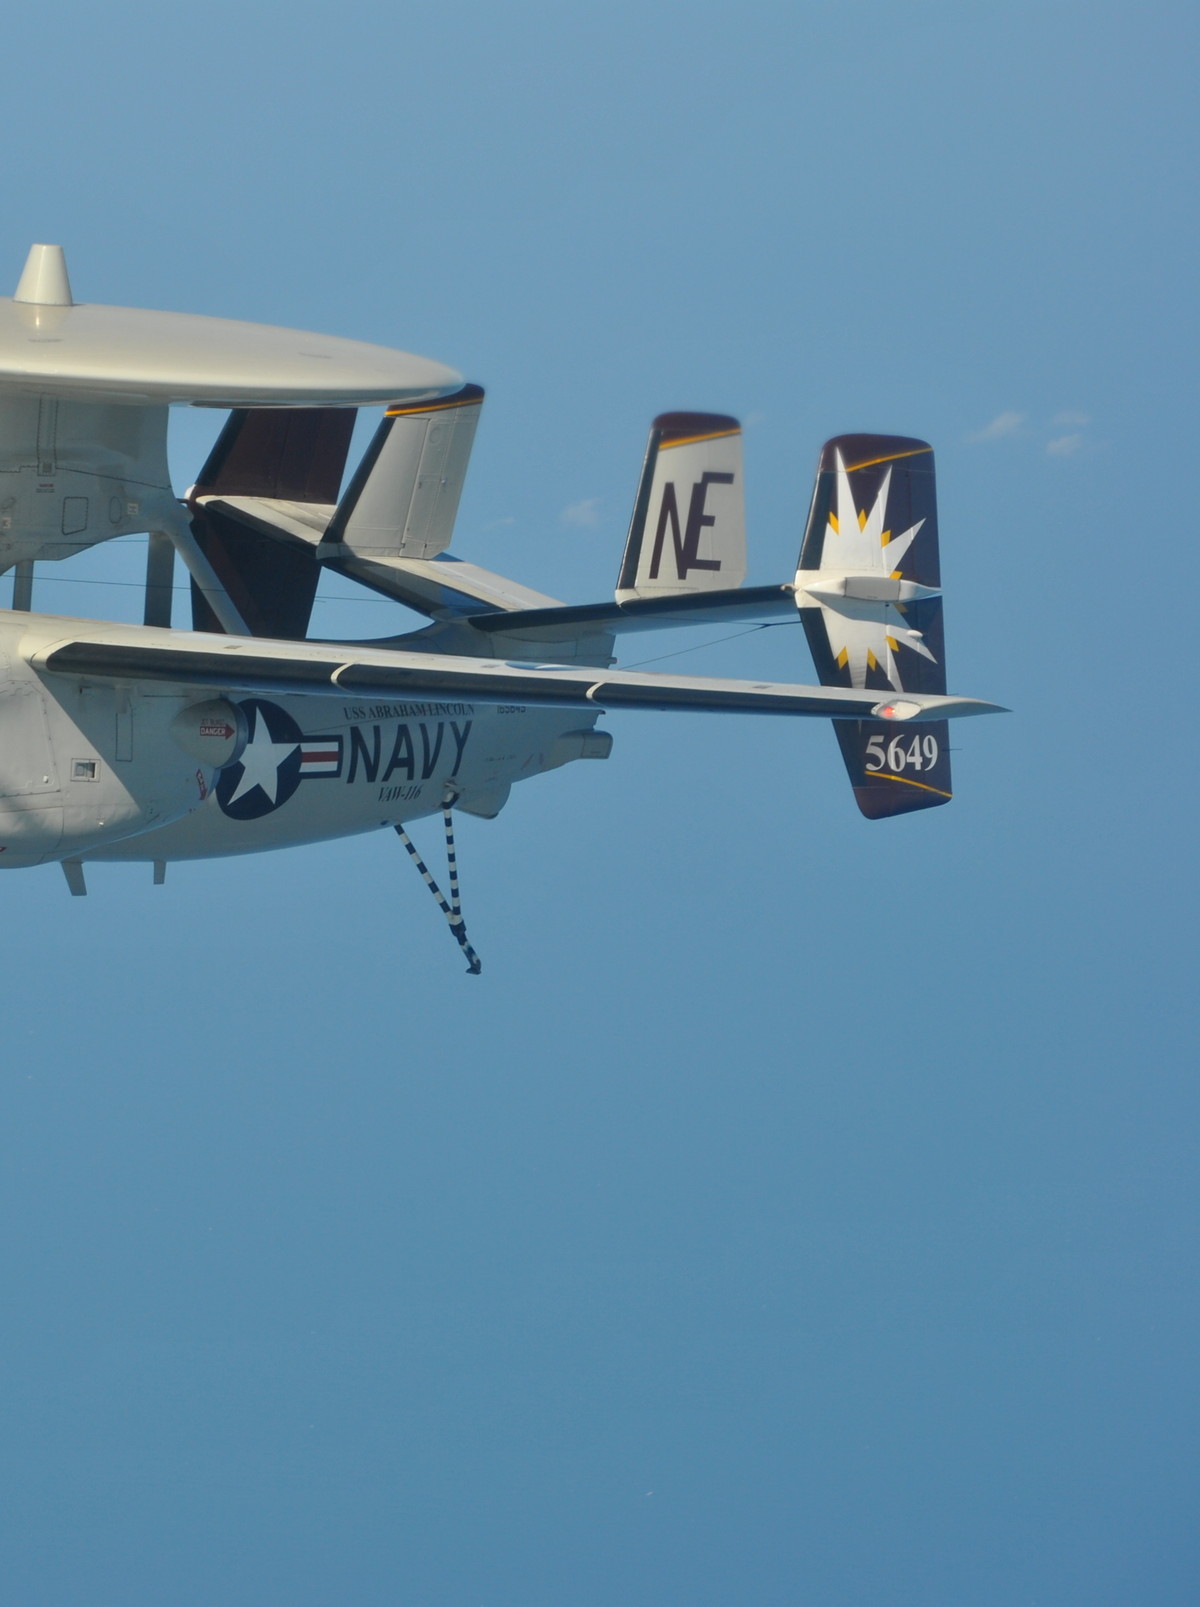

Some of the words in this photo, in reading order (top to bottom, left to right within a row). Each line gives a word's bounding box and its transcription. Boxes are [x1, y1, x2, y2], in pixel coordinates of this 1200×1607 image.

[649, 471, 735, 580] NE
[343, 706, 367, 720] USS
[368, 703, 427, 719] ABRAHAM
[428, 702, 474, 717] LINCOLN
[346, 720, 473, 784] NAVY
[865, 734, 938, 772] 5649
[378, 785, 424, 802] VAW-116
